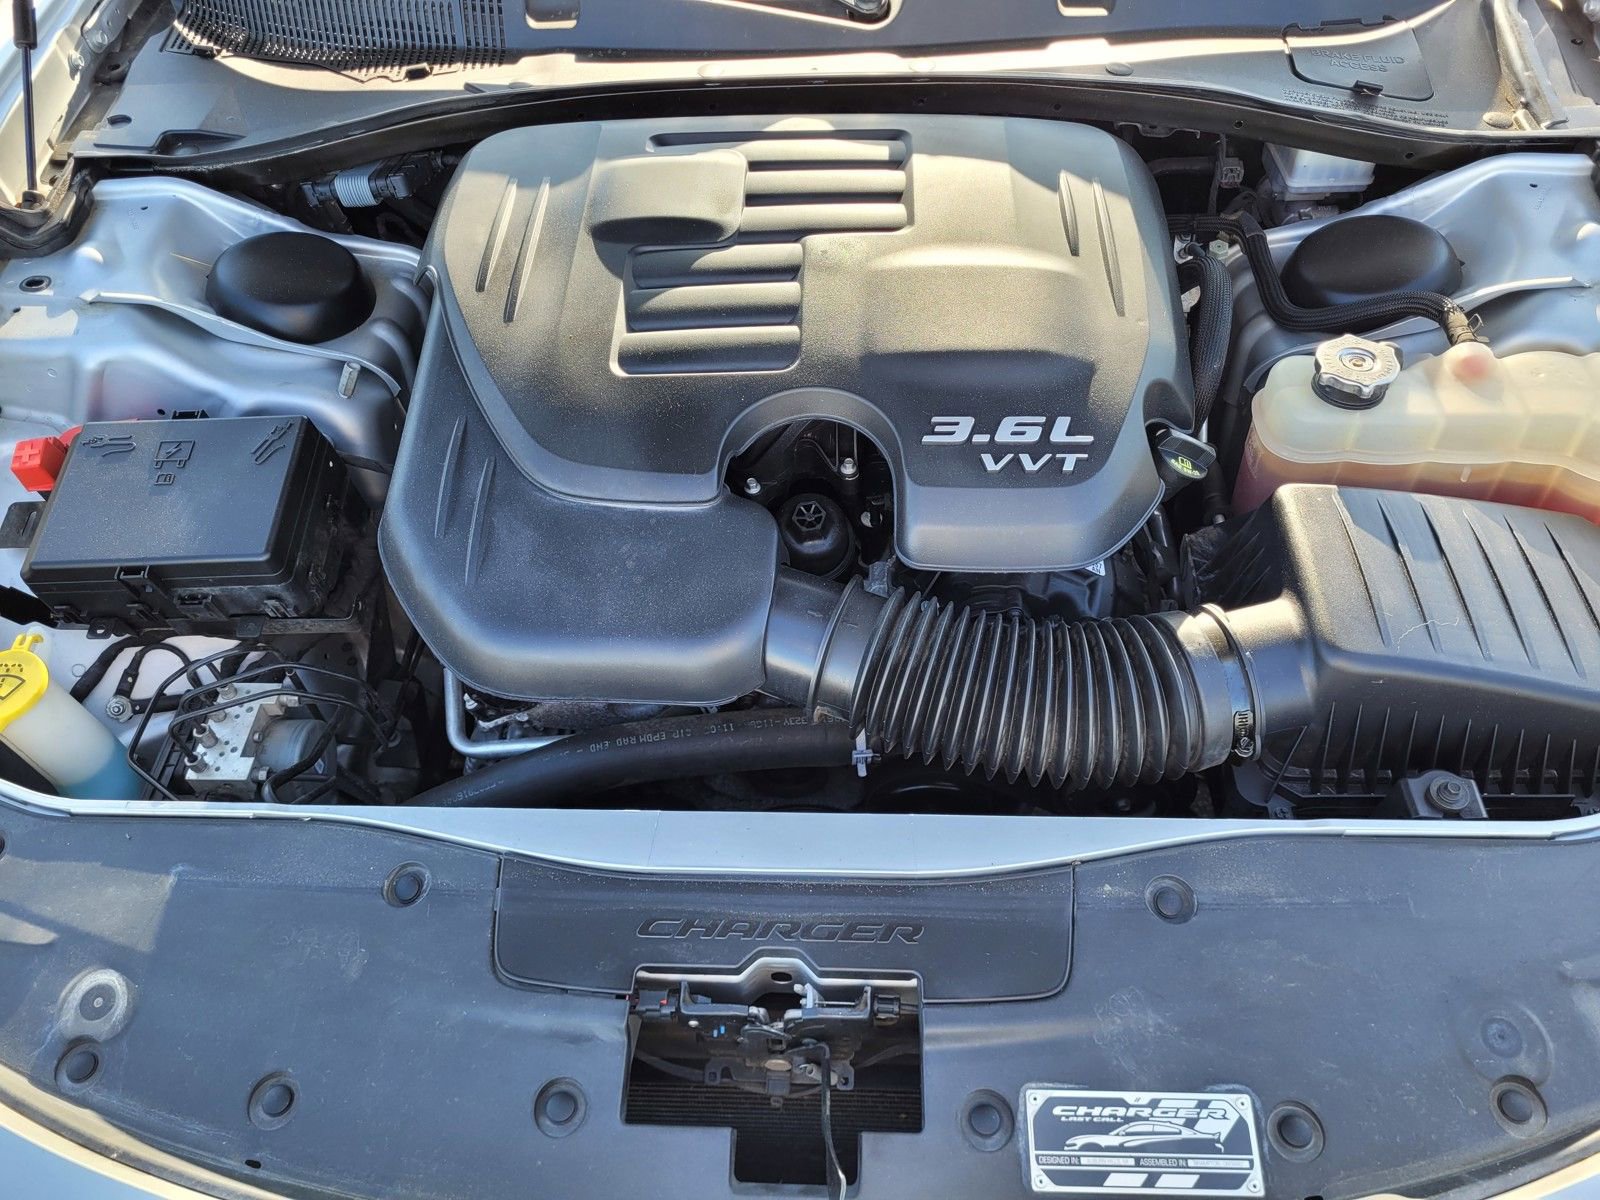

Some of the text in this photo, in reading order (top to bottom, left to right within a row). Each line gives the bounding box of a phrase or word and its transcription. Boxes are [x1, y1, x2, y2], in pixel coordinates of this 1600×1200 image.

[1311, 49, 1405, 65] BRAKE FLUID
[1330, 59, 1388, 72] ACCESS
[921, 415, 1095, 445] 3.6L
[980, 453, 1089, 474] VVT
[636, 917, 925, 945] CHARGER
[1052, 1105, 1230, 1120] CHARGER
[1038, 1155, 1070, 1165] DESIGNED
[1070, 1156, 1080, 1165] IN:
[1139, 1158, 1178, 1168] ASSEMBLED
